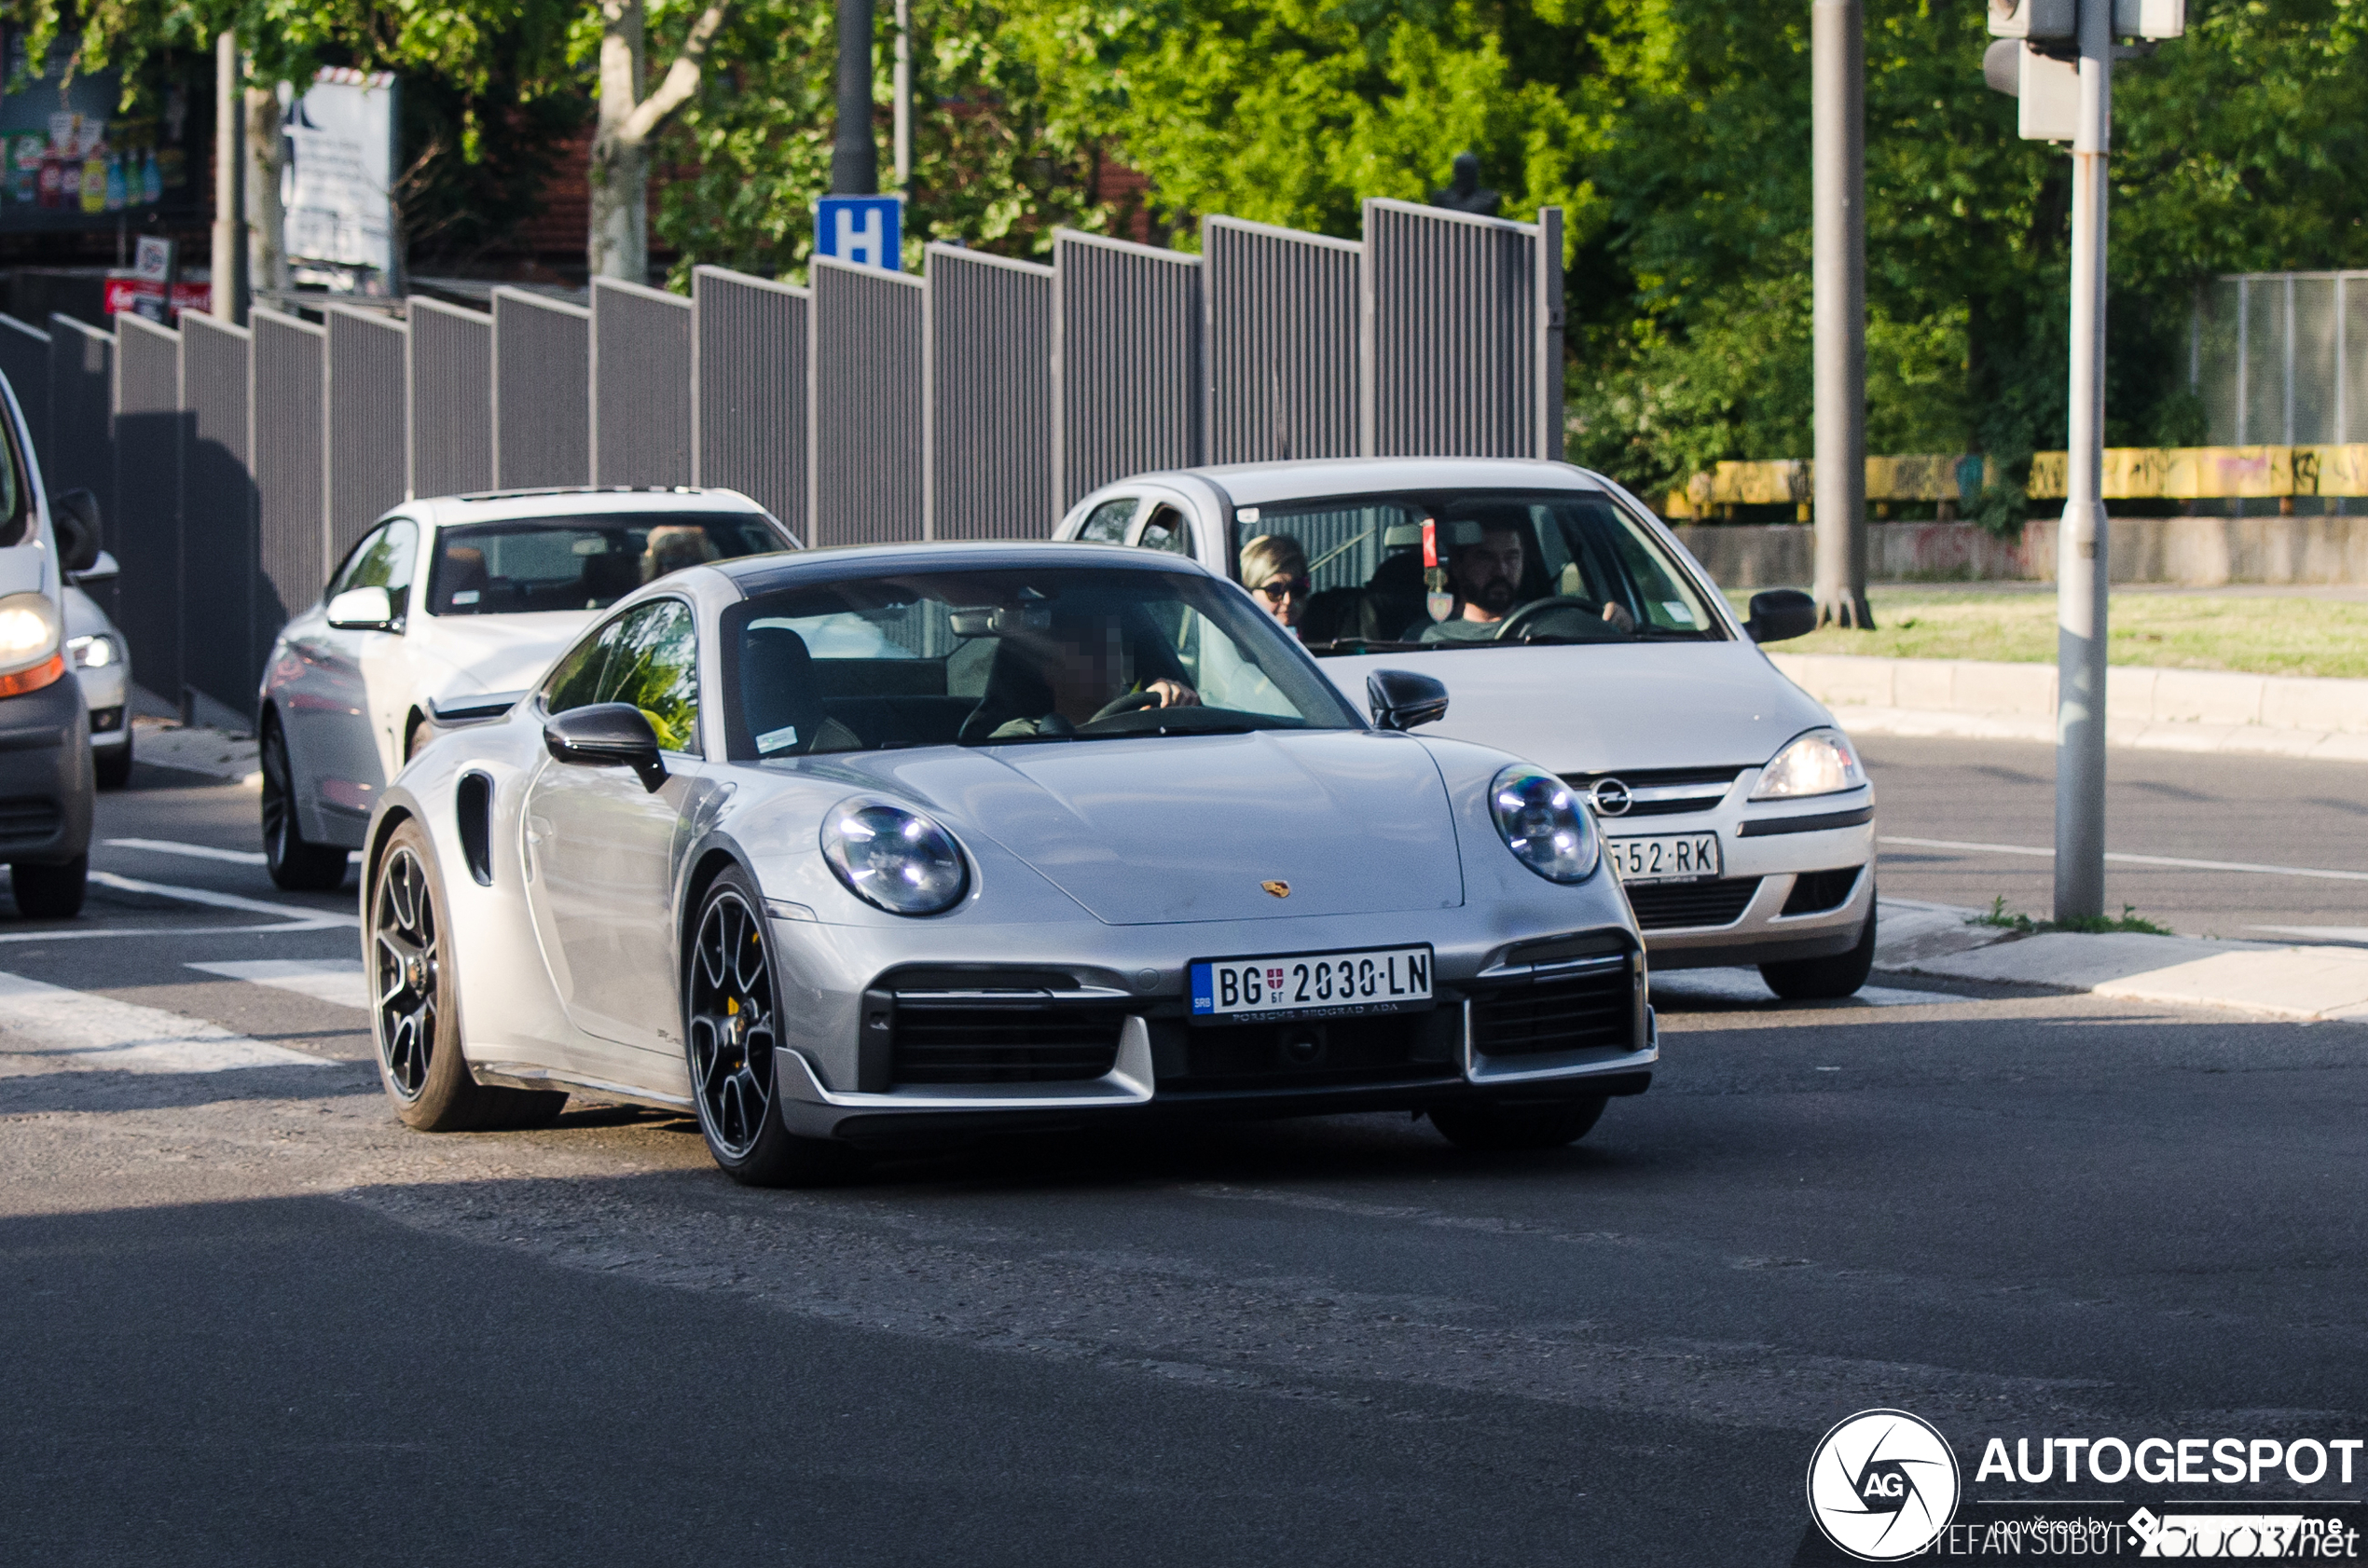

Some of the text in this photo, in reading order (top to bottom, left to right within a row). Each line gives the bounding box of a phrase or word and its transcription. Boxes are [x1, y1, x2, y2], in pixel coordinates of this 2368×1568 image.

[834, 207, 883, 268] H
[1219, 966, 1261, 1007] BG
[1194, 997, 1211, 1008] SRB
[1232, 1003, 1398, 1022] PORSCHE BEOGRAD ADA
